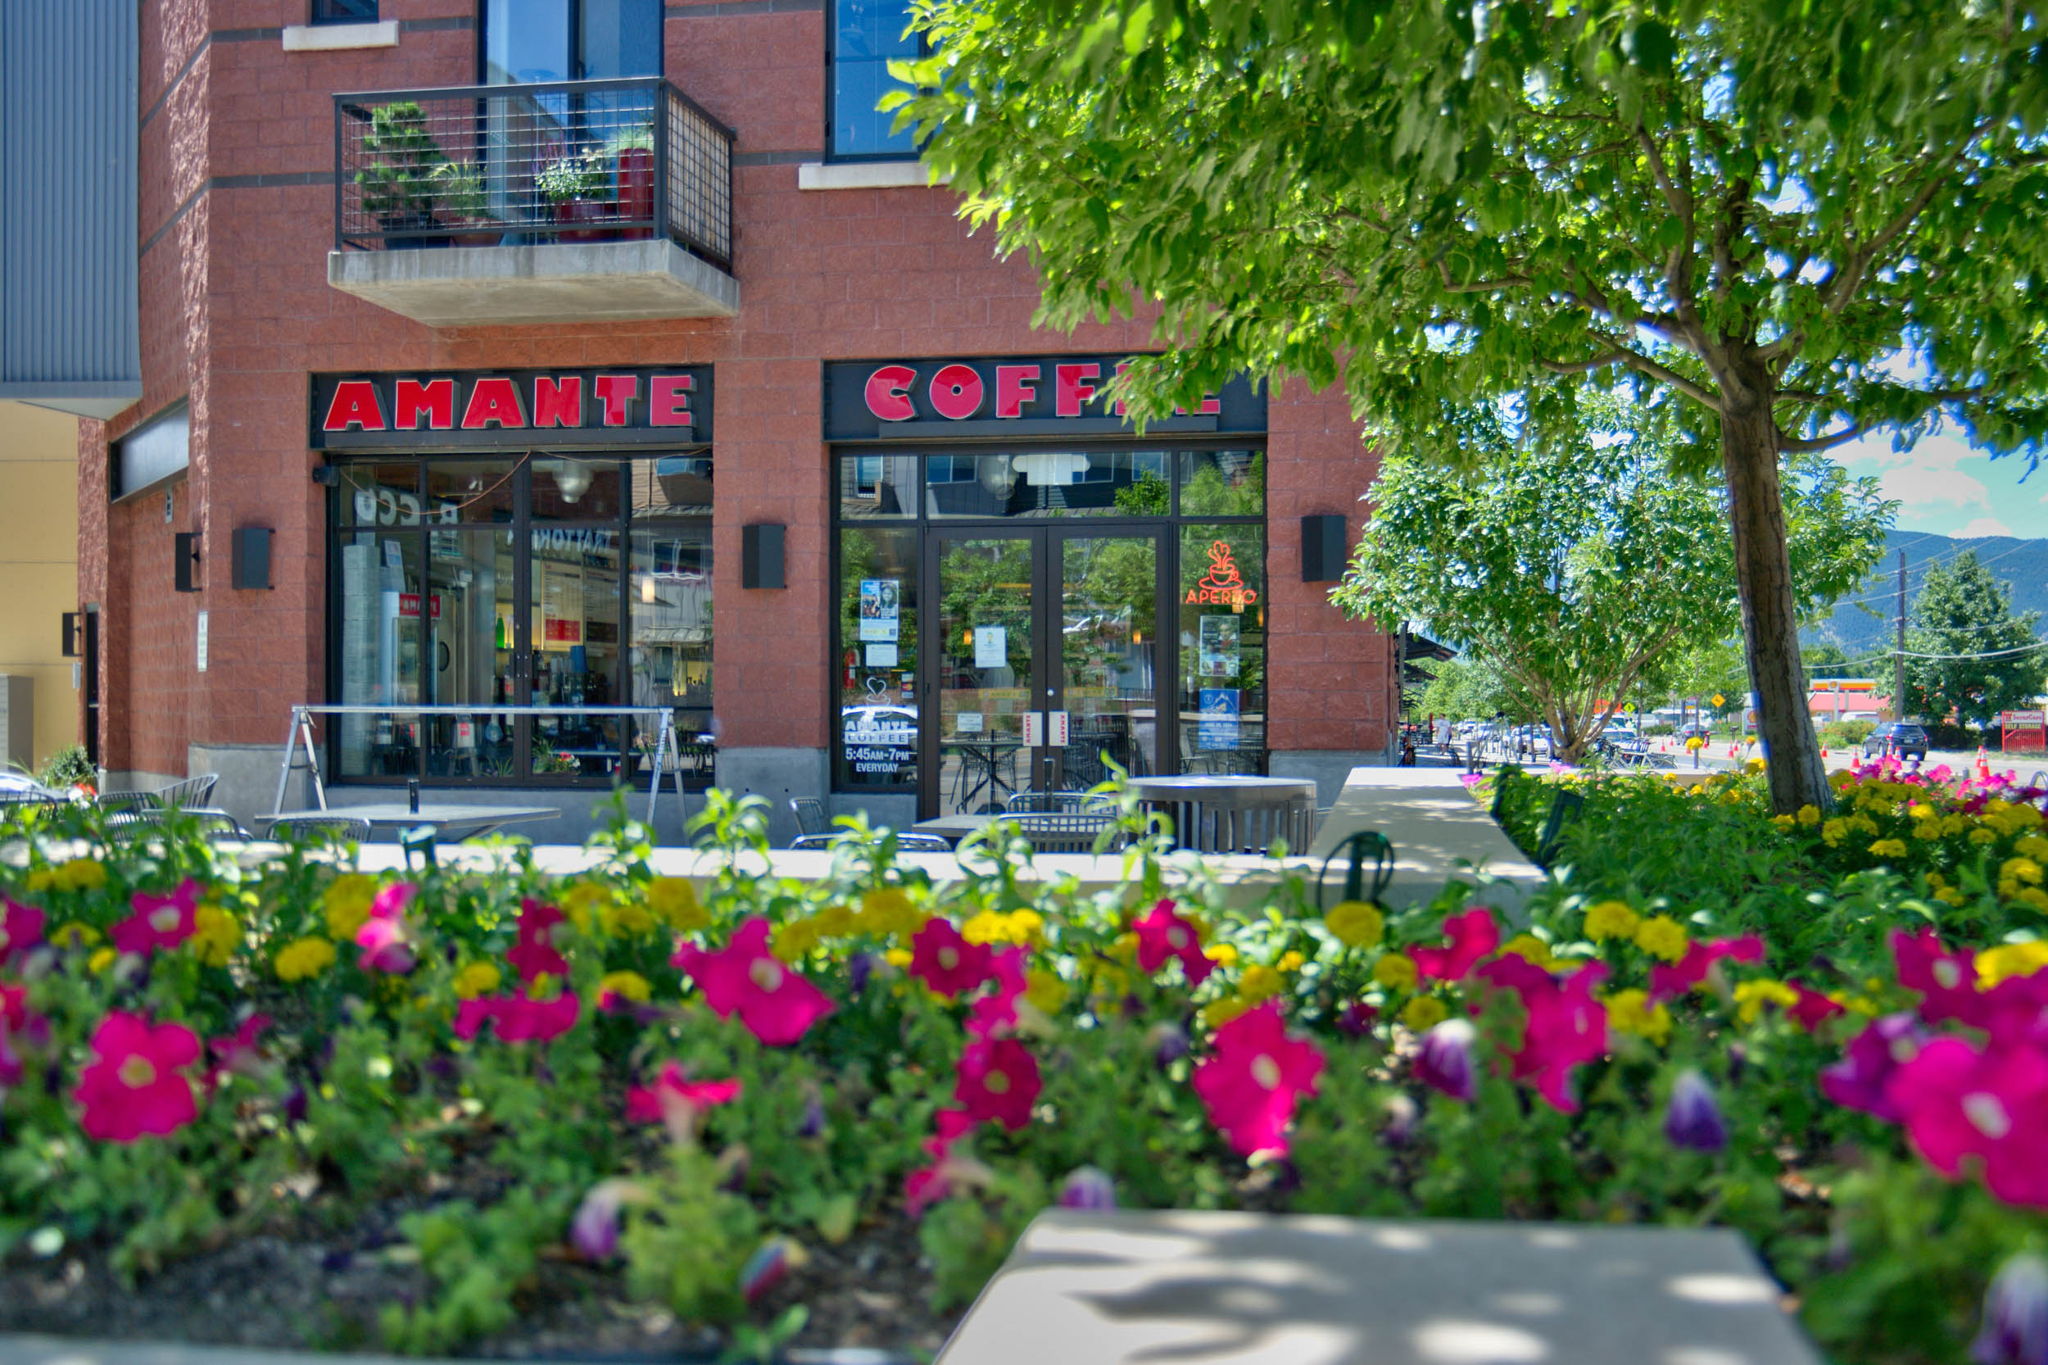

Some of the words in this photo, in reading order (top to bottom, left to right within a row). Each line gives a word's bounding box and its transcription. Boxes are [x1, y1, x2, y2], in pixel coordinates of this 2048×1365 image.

[865, 363, 1222, 421] COFF
[323, 375, 696, 431] AMANTE
[1185, 589, 1257, 604] APERTO
[845, 721, 909, 732] AMANTE
[848, 733, 905, 743] COFFEE
[856, 763, 898, 773] EVERYDAY
